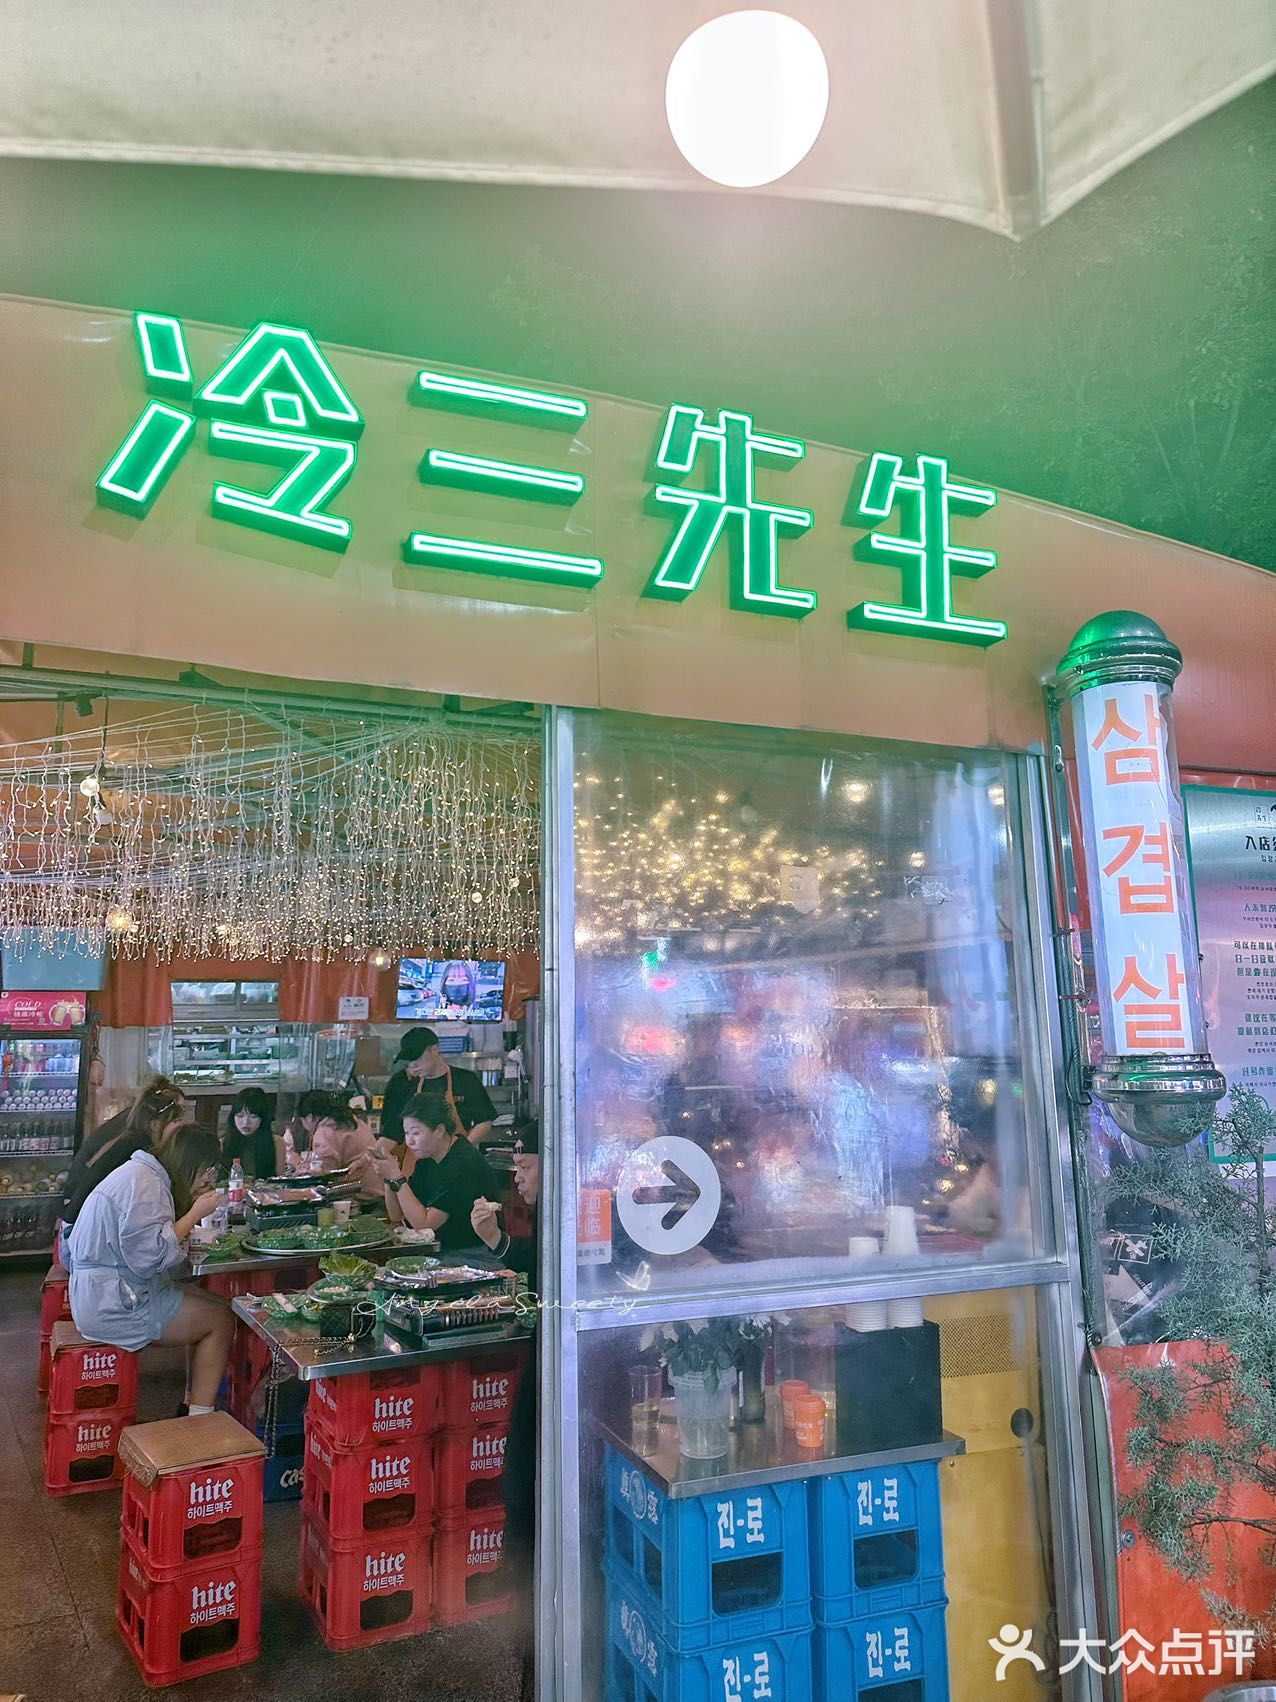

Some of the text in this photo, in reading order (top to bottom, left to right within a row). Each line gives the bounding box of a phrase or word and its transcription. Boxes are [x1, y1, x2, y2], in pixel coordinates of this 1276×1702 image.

[97, 312, 1008, 643] 冷三先生
[1245, 836, 1276, 851] 入店
[1091, 693, 1185, 1049] 삼겹살
[1234, 941, 1276, 951] 可以在排队
[83, 1352, 117, 1371] hite
[472, 1376, 510, 1400] hite
[374, 1395, 414, 1419] hite
[77, 1422, 112, 1442] hite
[372, 1418, 413, 1433] 하이트맥주
[472, 1434, 507, 1458] hite
[370, 1455, 410, 1480] hite
[189, 1477, 234, 1505] hite
[368, 1477, 410, 1494] 하이트맥주
[187, 1500, 233, 1520] 하이트맥주
[470, 1527, 504, 1552] hite
[365, 1552, 406, 1577] hite
[191, 1580, 237, 1610] hite
[363, 1574, 405, 1592] 하이트맥주
[189, 1602, 236, 1625] 하이트맥주
